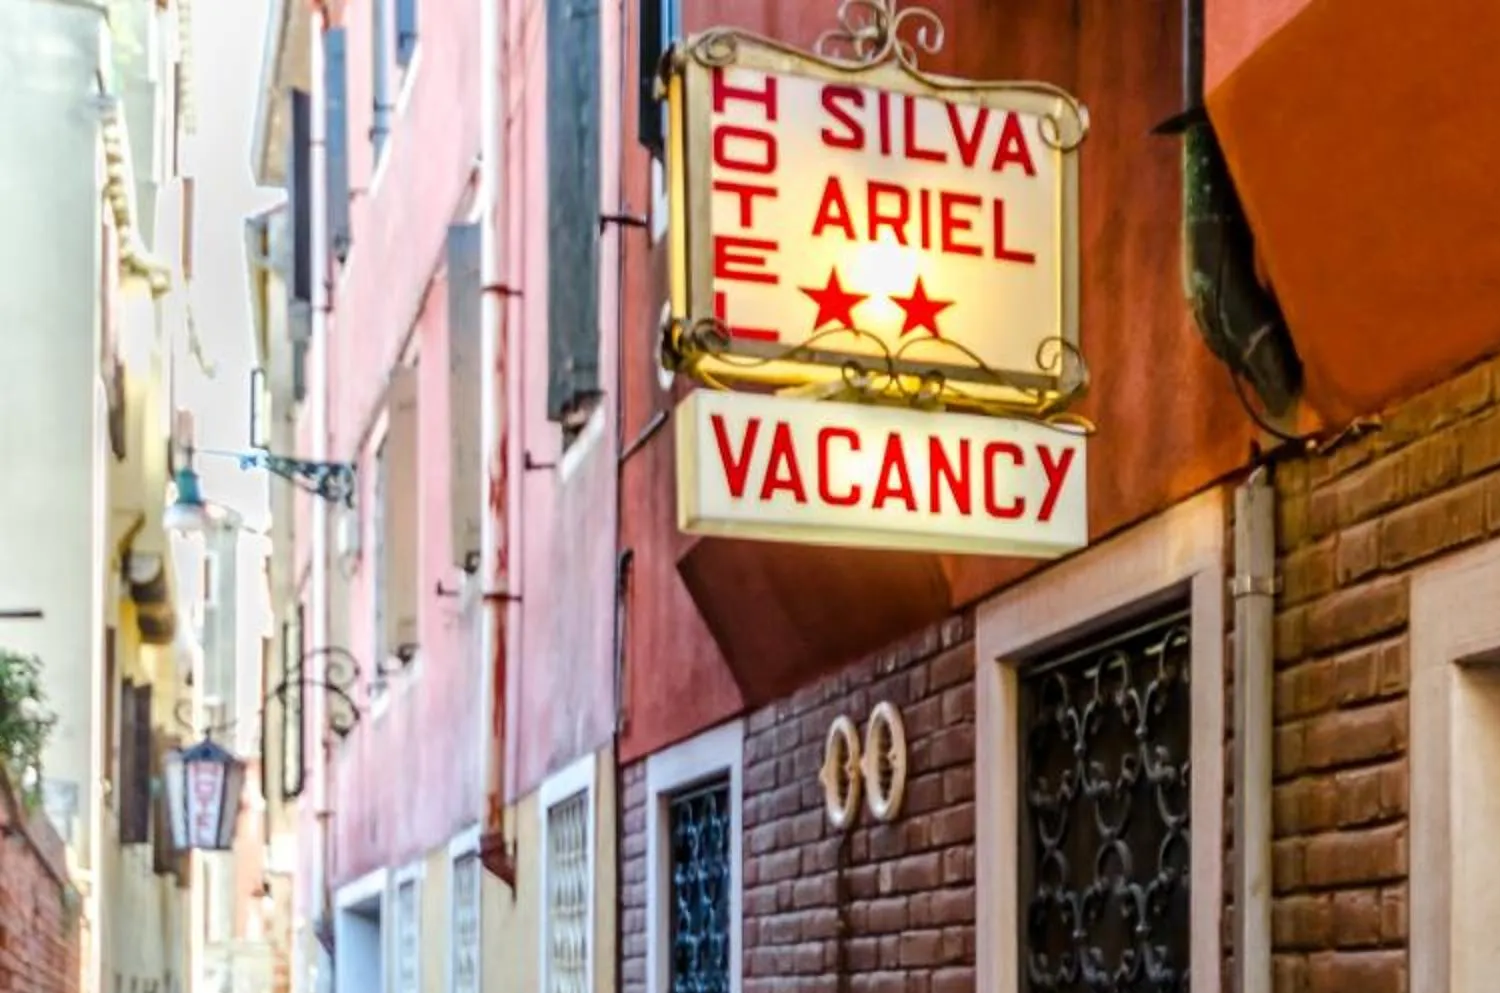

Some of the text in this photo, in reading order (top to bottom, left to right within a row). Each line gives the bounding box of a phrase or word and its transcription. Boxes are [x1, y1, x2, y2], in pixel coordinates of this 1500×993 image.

[820, 84, 1036, 177] SILVA
[713, 67, 780, 342] HOTEL
[812, 175, 1036, 265] ARIEL
[710, 415, 1075, 523] VACANCY
